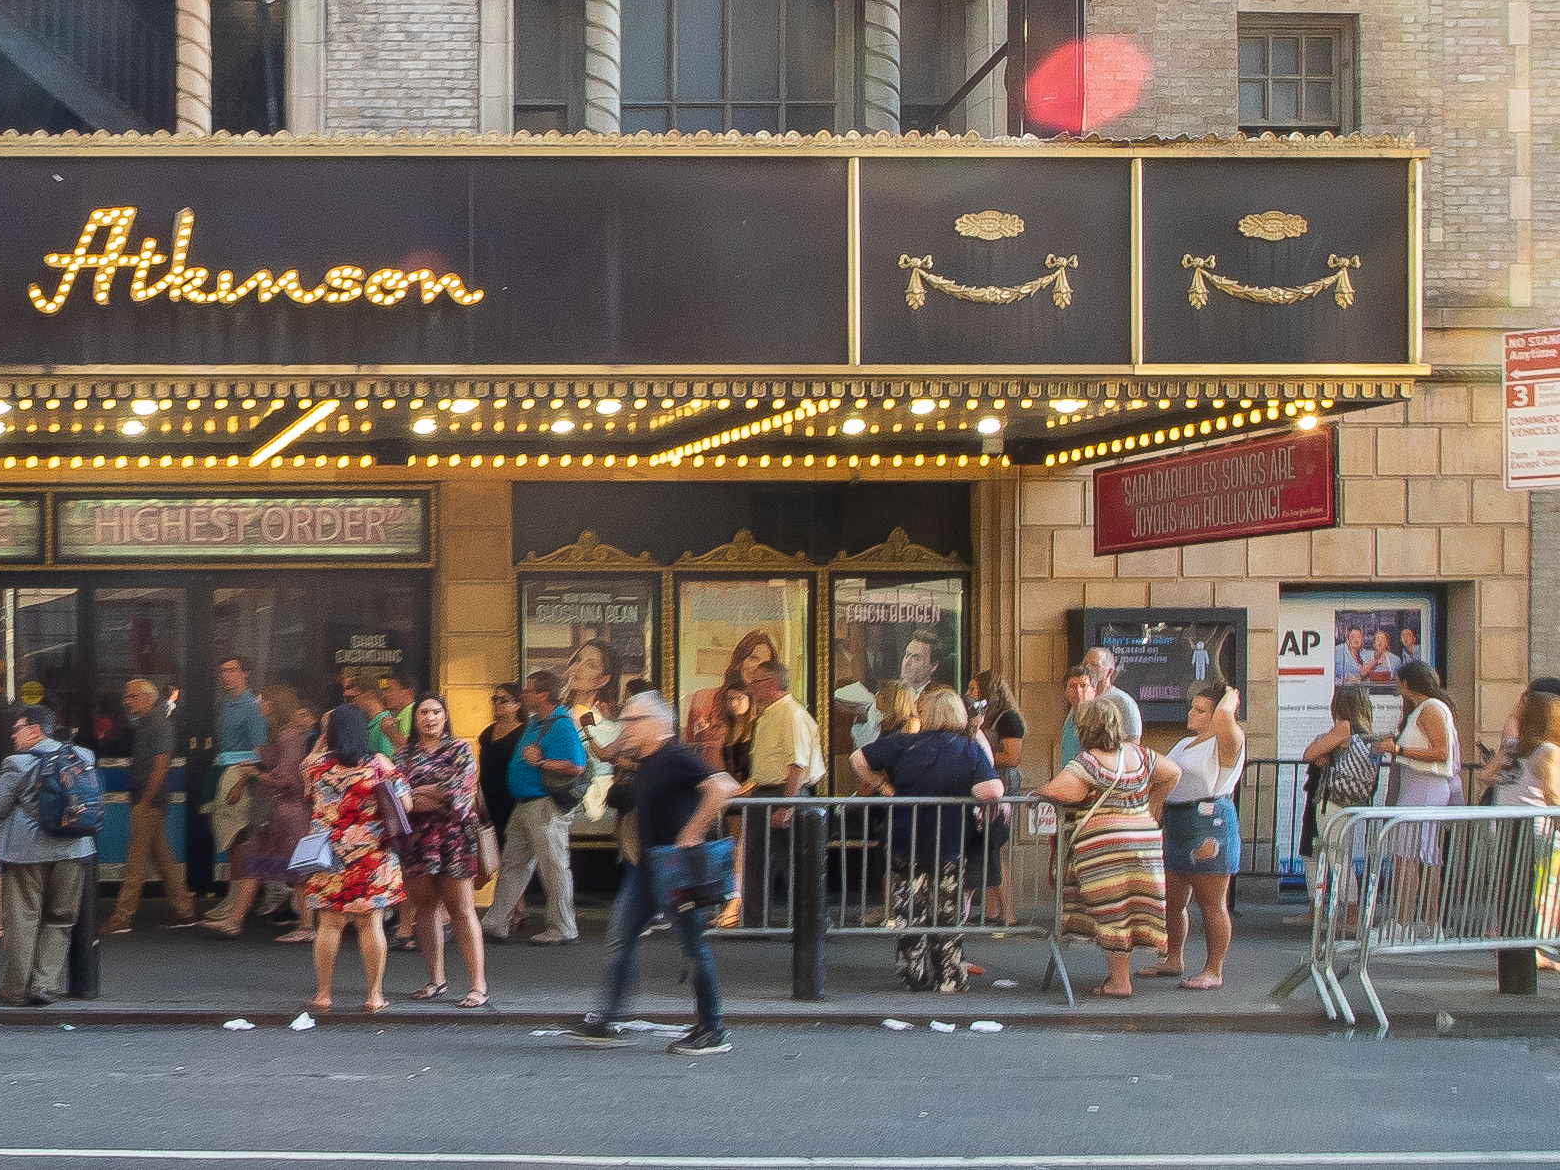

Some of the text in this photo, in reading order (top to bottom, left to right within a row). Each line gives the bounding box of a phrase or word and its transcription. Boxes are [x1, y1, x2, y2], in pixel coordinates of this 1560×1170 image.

[29, 206, 485, 315] Atkinson
[1512, 385, 1529, 407] 3
[1222, 451, 1267, 490] SONGS
[1270, 445, 1296, 482] ARE
[94, 506, 253, 543] HIGHEST
[1131, 502, 1178, 538] JOYOUS
